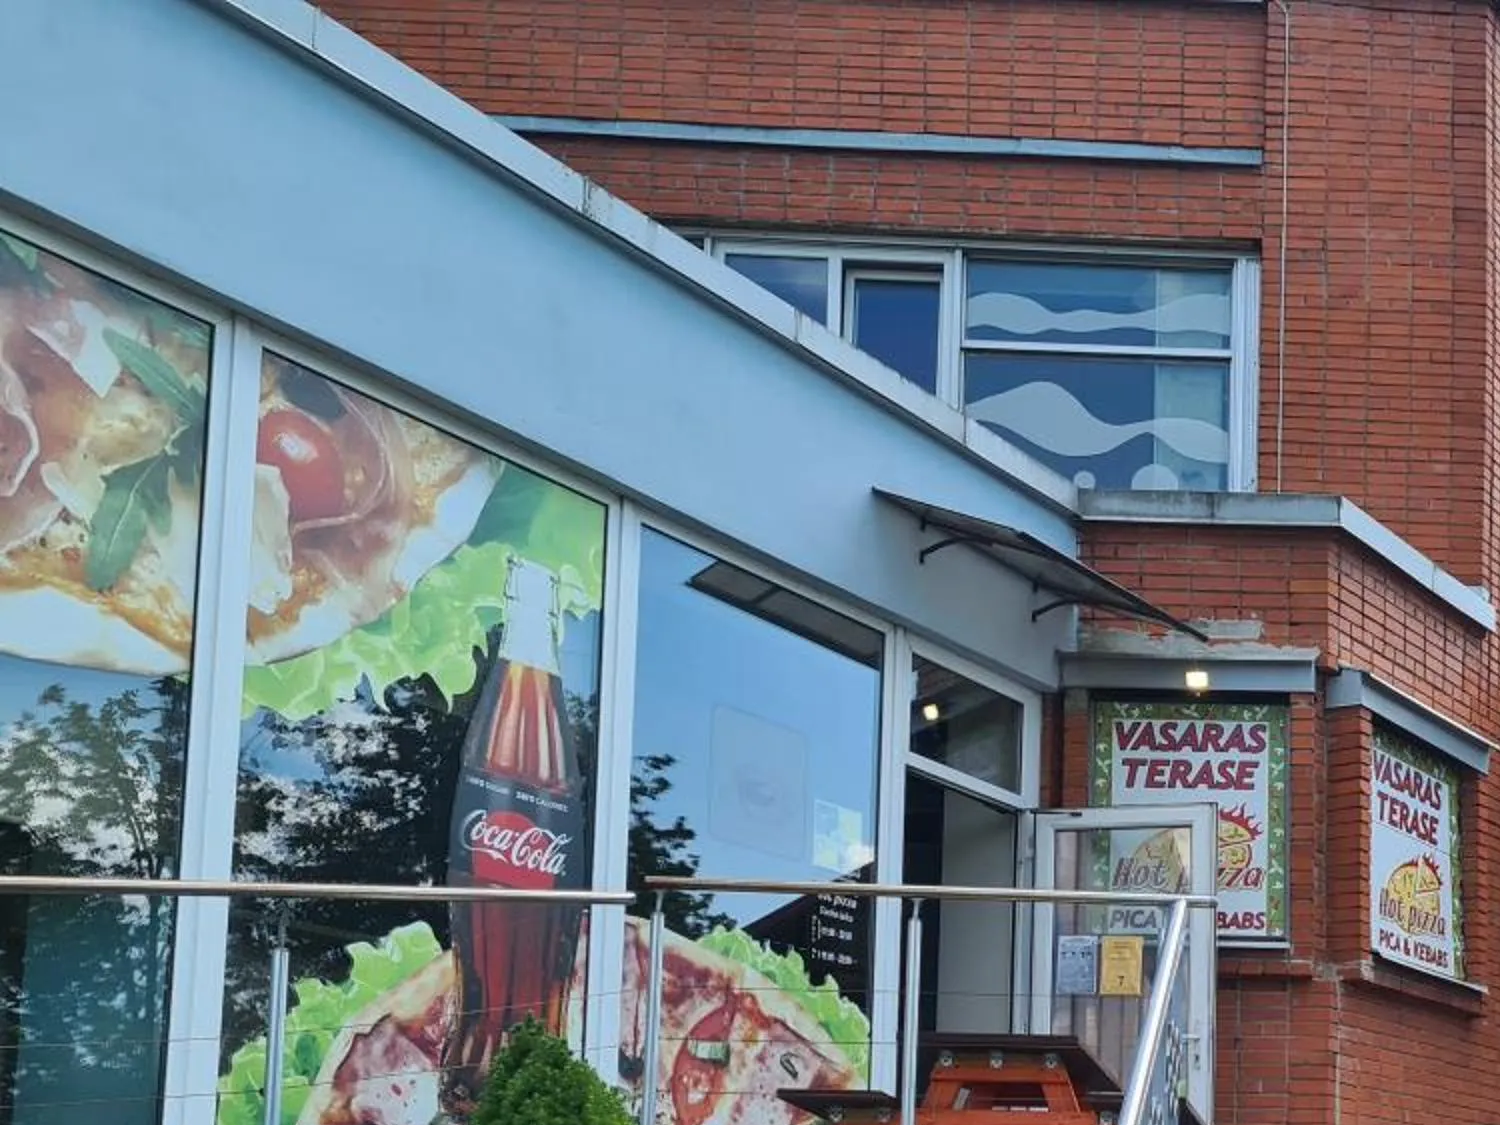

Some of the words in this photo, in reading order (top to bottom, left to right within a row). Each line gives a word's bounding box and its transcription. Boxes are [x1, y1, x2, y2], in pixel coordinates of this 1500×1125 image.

[1115, 722, 1266, 753] VASARAS
[1122, 758, 1259, 790] TERASE
[1373, 750, 1441, 810] VASARAS
[1377, 790, 1439, 845] TERASE
[1112, 857, 1166, 889] Hot
[1109, 909, 1158, 930] PICA
[1379, 887, 1405, 922] Hot
[1407, 905, 1446, 936] pizza
[1379, 928, 1401, 951] PICA
